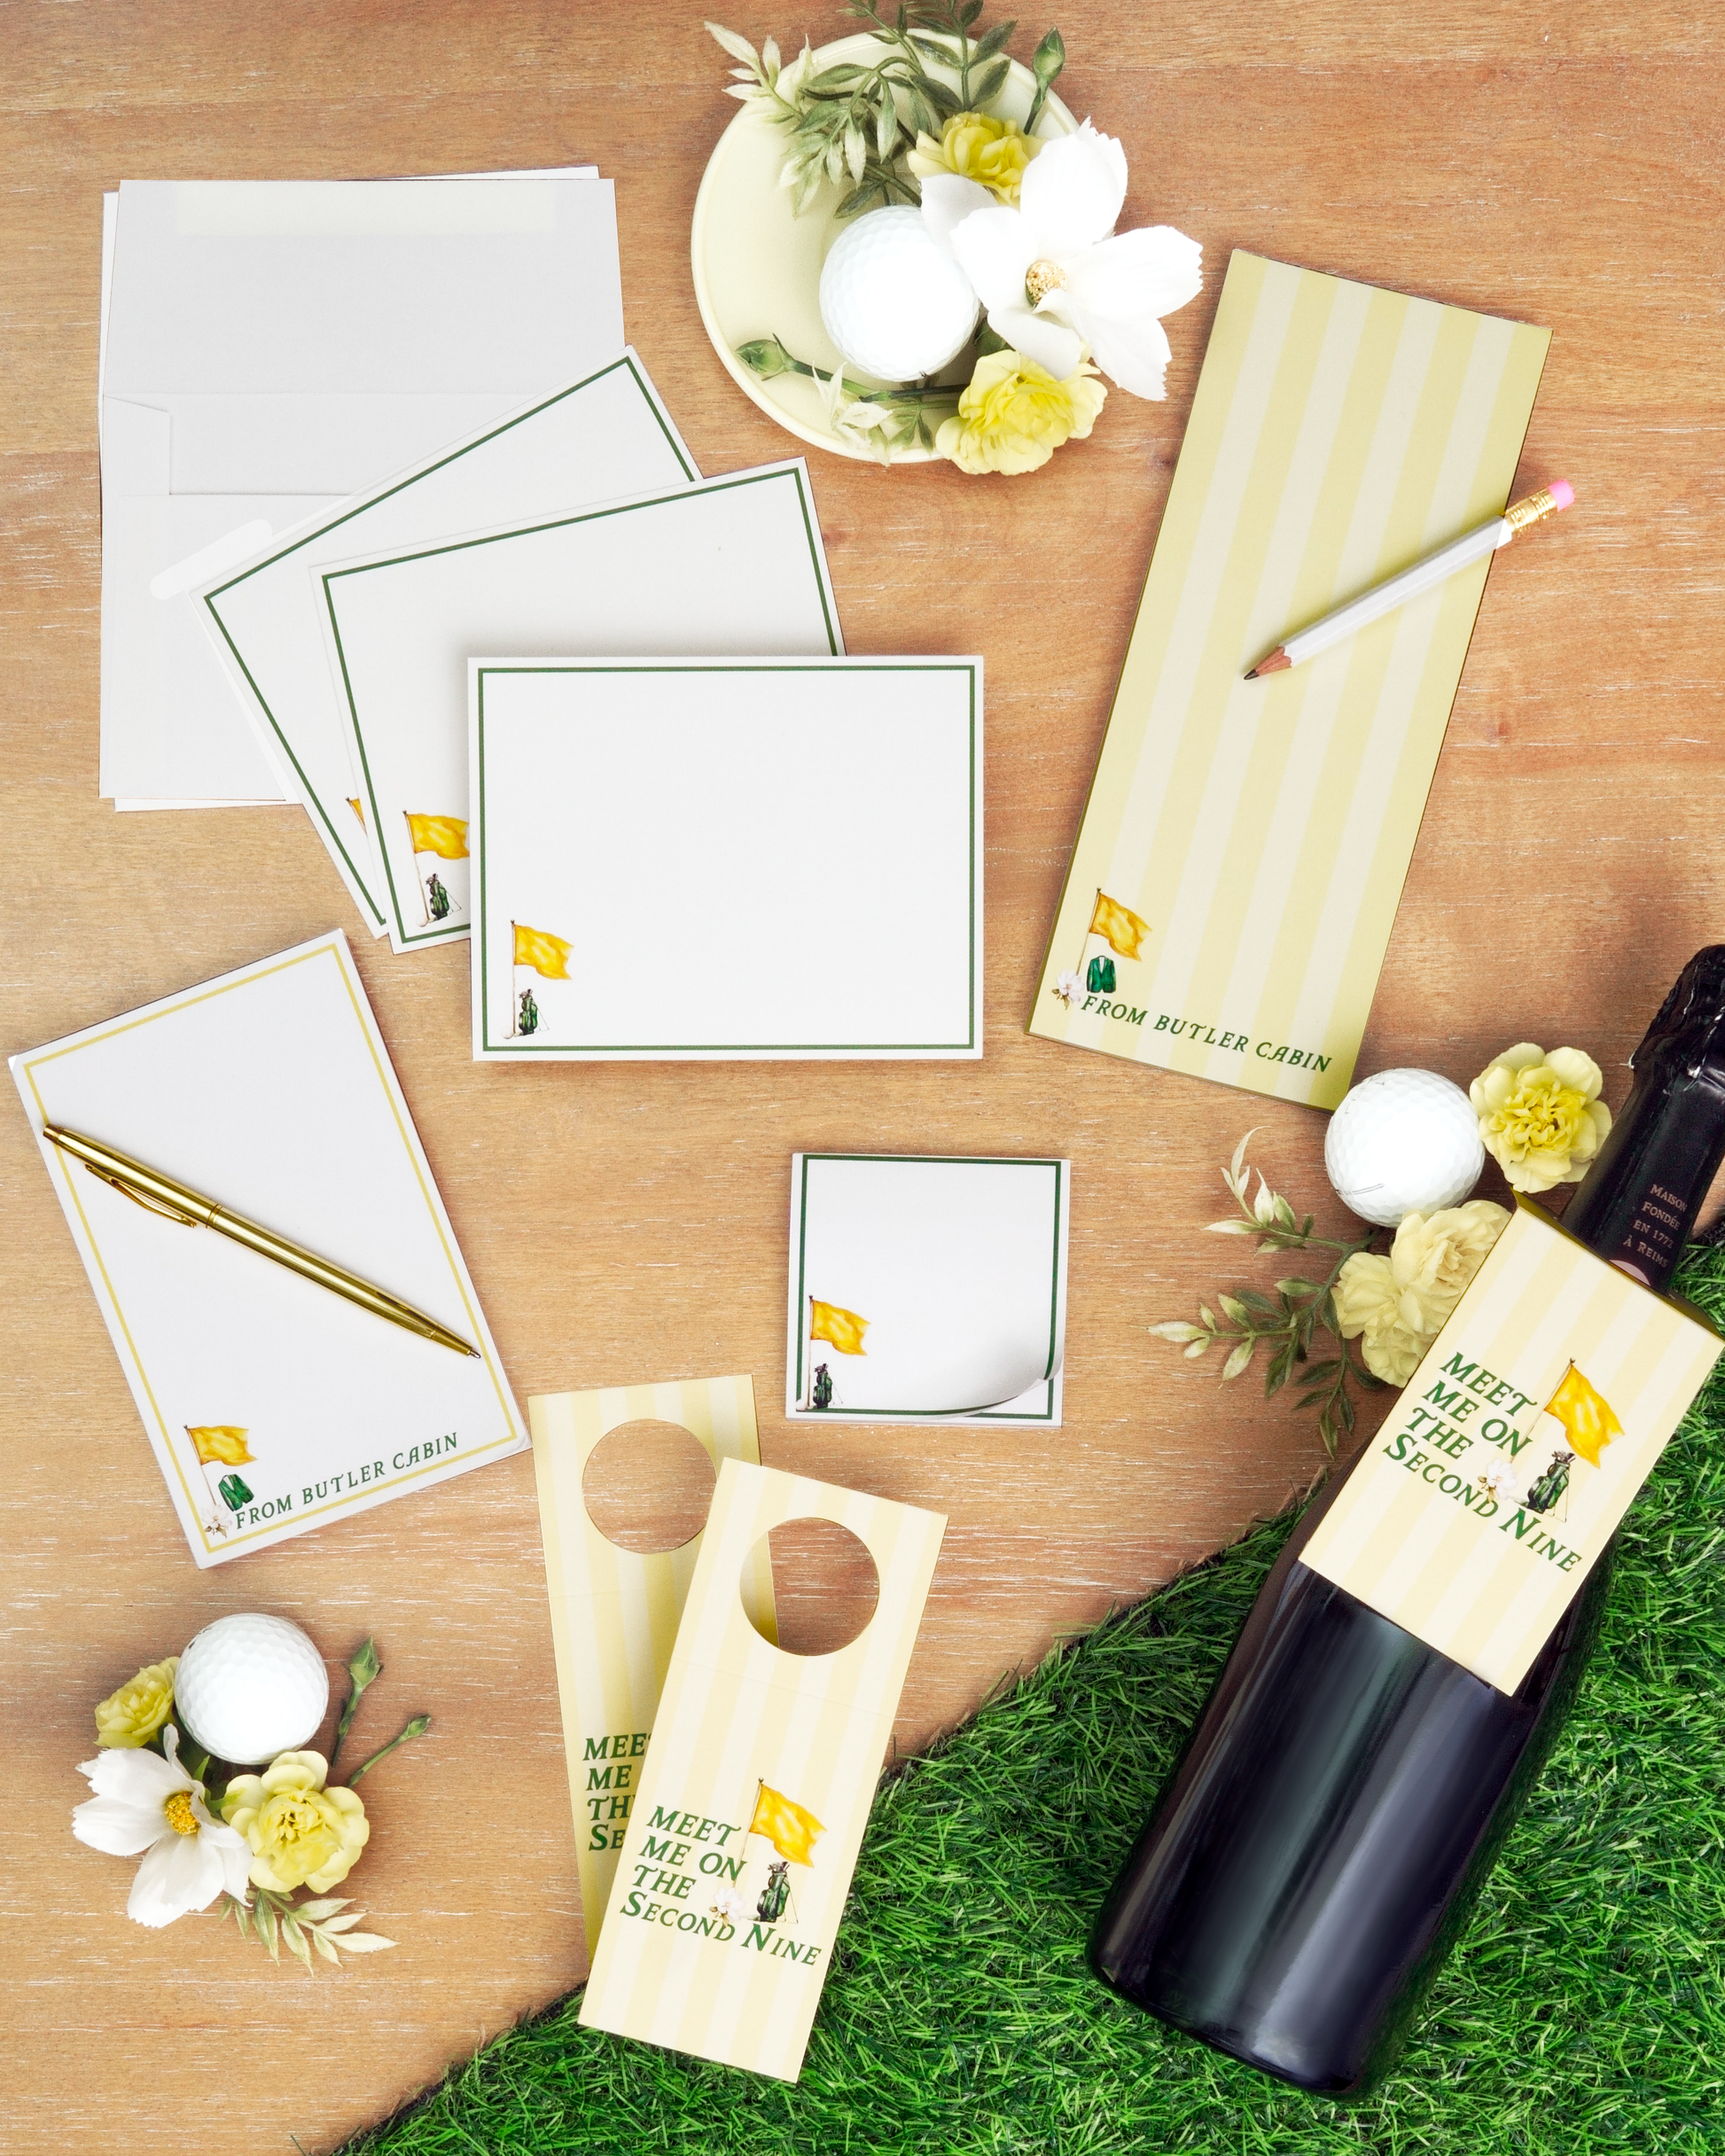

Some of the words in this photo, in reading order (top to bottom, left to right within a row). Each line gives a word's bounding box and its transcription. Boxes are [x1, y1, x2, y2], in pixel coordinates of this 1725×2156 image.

[1081, 996, 1149, 1026] FROM
[1153, 1014, 1249, 1053] BUTLER
[1255, 1042, 1333, 1073] CABIN
[1641, 1201, 1682, 1231] FONDÉE
[1650, 1183, 1688, 1213] MAISON
[1633, 1220, 1651, 1233] EN
[1623, 1235, 1632, 1248] À
[1636, 1241, 1668, 1269] REIMS
[1440, 1351, 1538, 1418] MEET
[1404, 1407, 1475, 1460] THE
[1421, 1379, 1480, 1424] ME
[1480, 1418, 1534, 1457] ON
[235, 1495, 293, 1530] FROM
[301, 1461, 386, 1505] BUTLER
[392, 1432, 459, 1470] CABIN
[582, 1732, 652, 1762] MEE
[585, 1764, 632, 1792] ME
[587, 1794, 635, 1821] TH
[646, 1805, 742, 1847] MEET
[638, 1835, 691, 1867] ME
[699, 1852, 748, 1882] ON
[632, 1864, 697, 1900] THE
